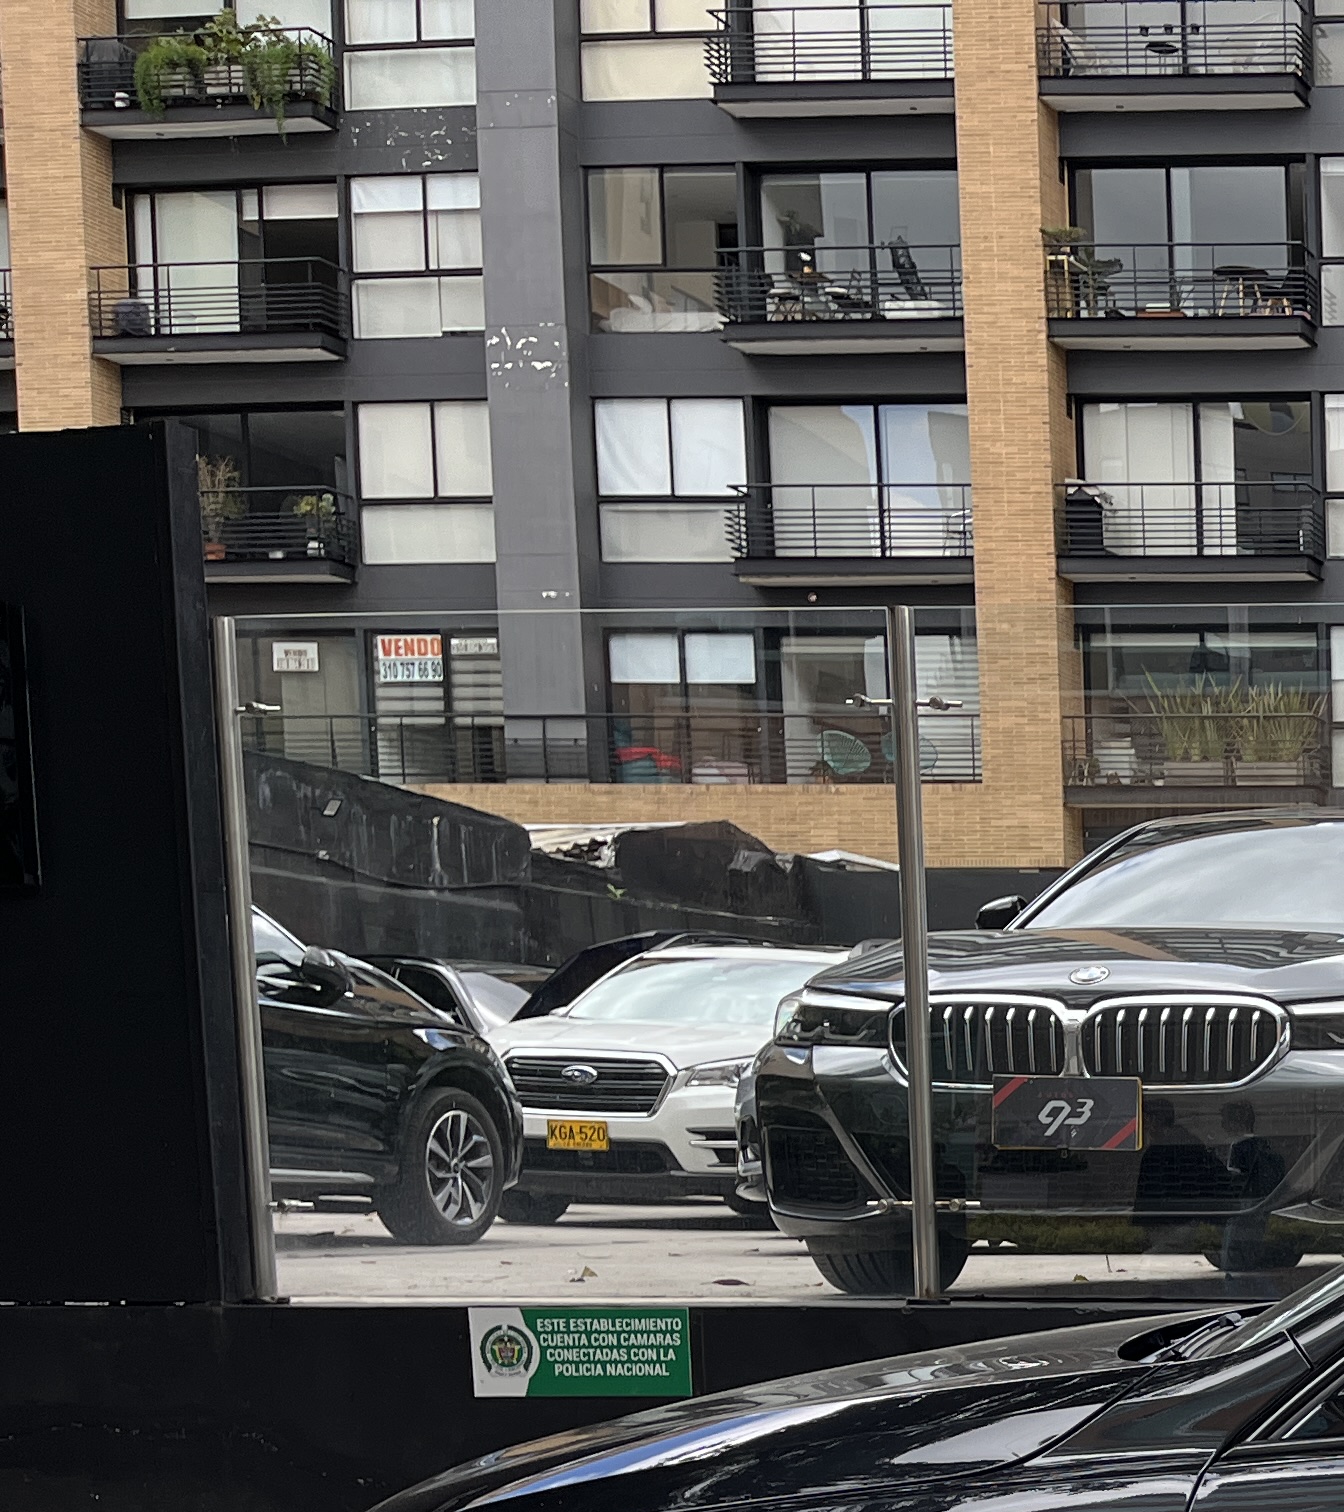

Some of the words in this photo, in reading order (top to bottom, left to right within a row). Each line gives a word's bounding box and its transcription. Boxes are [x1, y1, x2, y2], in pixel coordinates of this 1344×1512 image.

[381, 637, 442, 657] VENDO
[382, 661, 398, 679] 310
[400, 662, 415, 678] 757
[431, 660, 442, 678] 90
[1038, 1098, 1094, 1137] 93
[536, 1318, 567, 1332] ESTE
[569, 1317, 682, 1332] ESTABLECIMIENTO
[539, 1333, 589, 1347] CUENTA
[590, 1333, 618, 1346] CON
[620, 1333, 681, 1346] CAMARAS
[546, 1348, 627, 1362] CONECTADAS
[630, 1348, 657, 1361] CON
[660, 1348, 676, 1361] LA
[554, 1363, 604, 1377] POLICIA
[606, 1363, 670, 1376] NACIONAL
